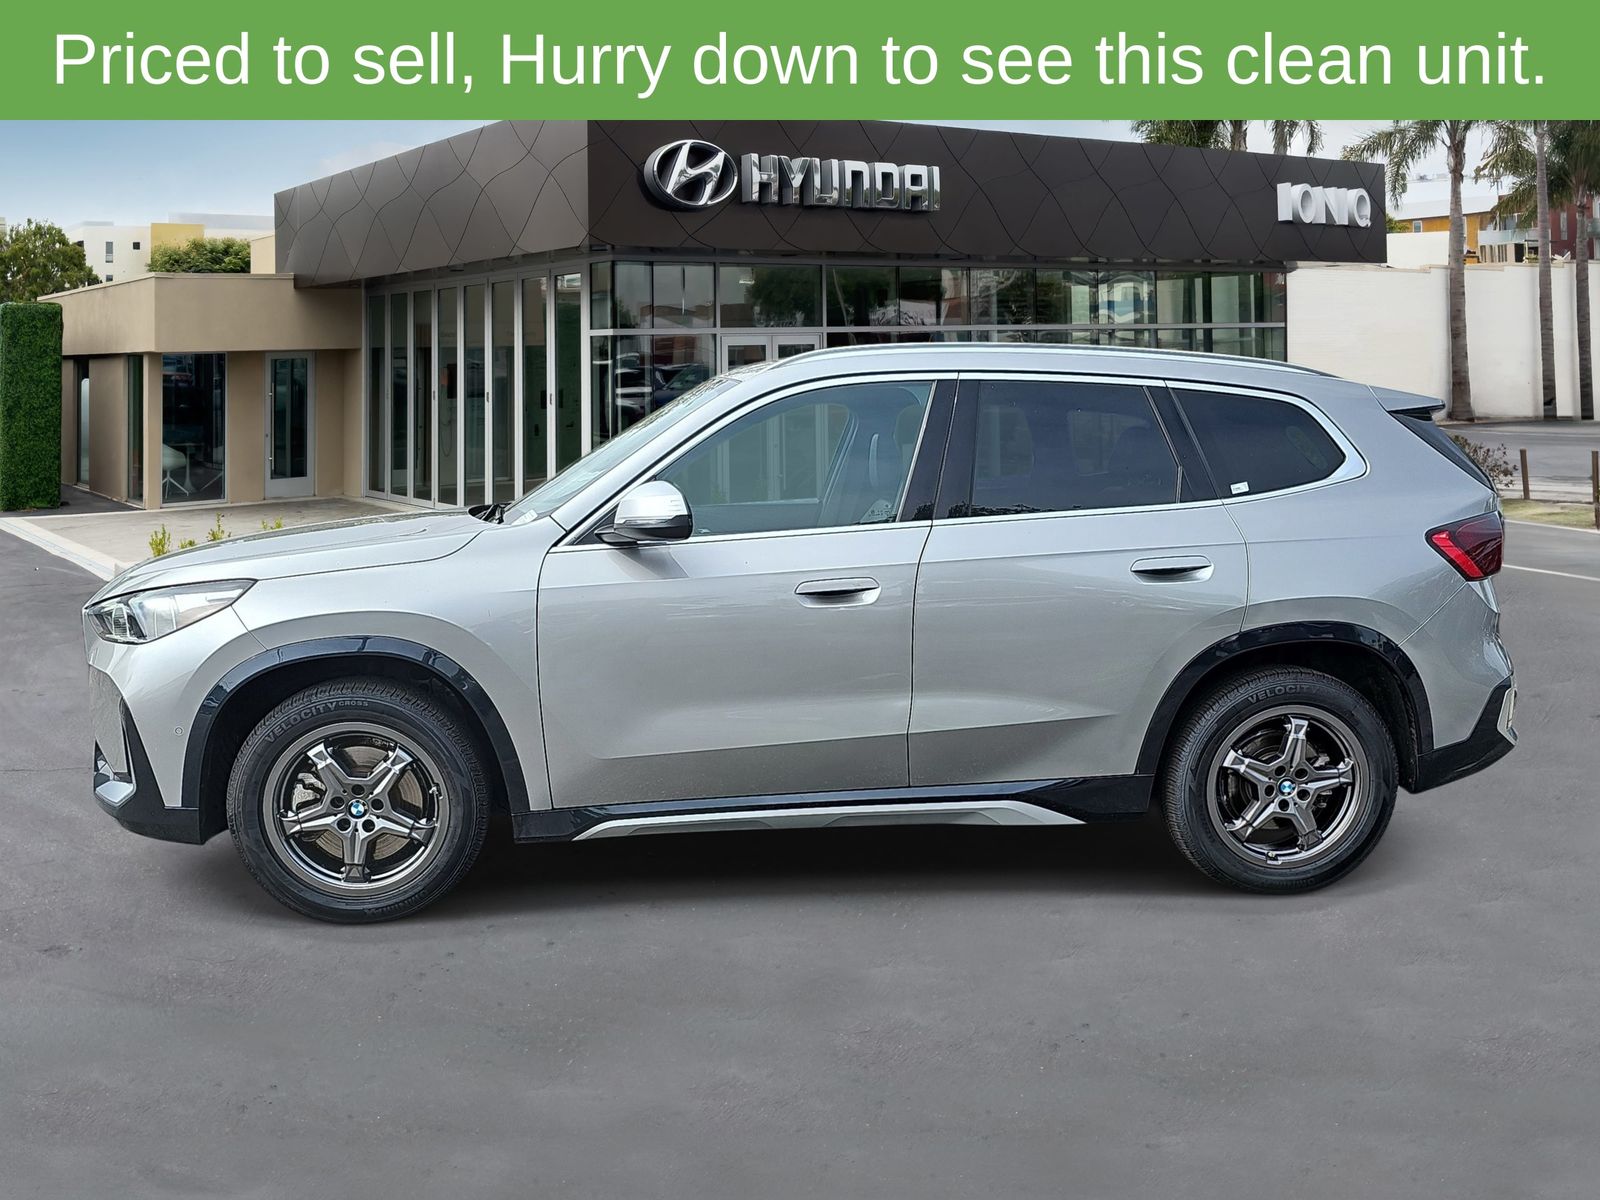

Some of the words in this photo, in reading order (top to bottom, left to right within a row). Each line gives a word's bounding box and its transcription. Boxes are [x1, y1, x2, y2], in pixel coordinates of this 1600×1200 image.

[741, 152, 940, 211] HYUNDAI
[1277, 182, 1371, 228] IONIQ
[265, 701, 337, 743] VELOCITY
